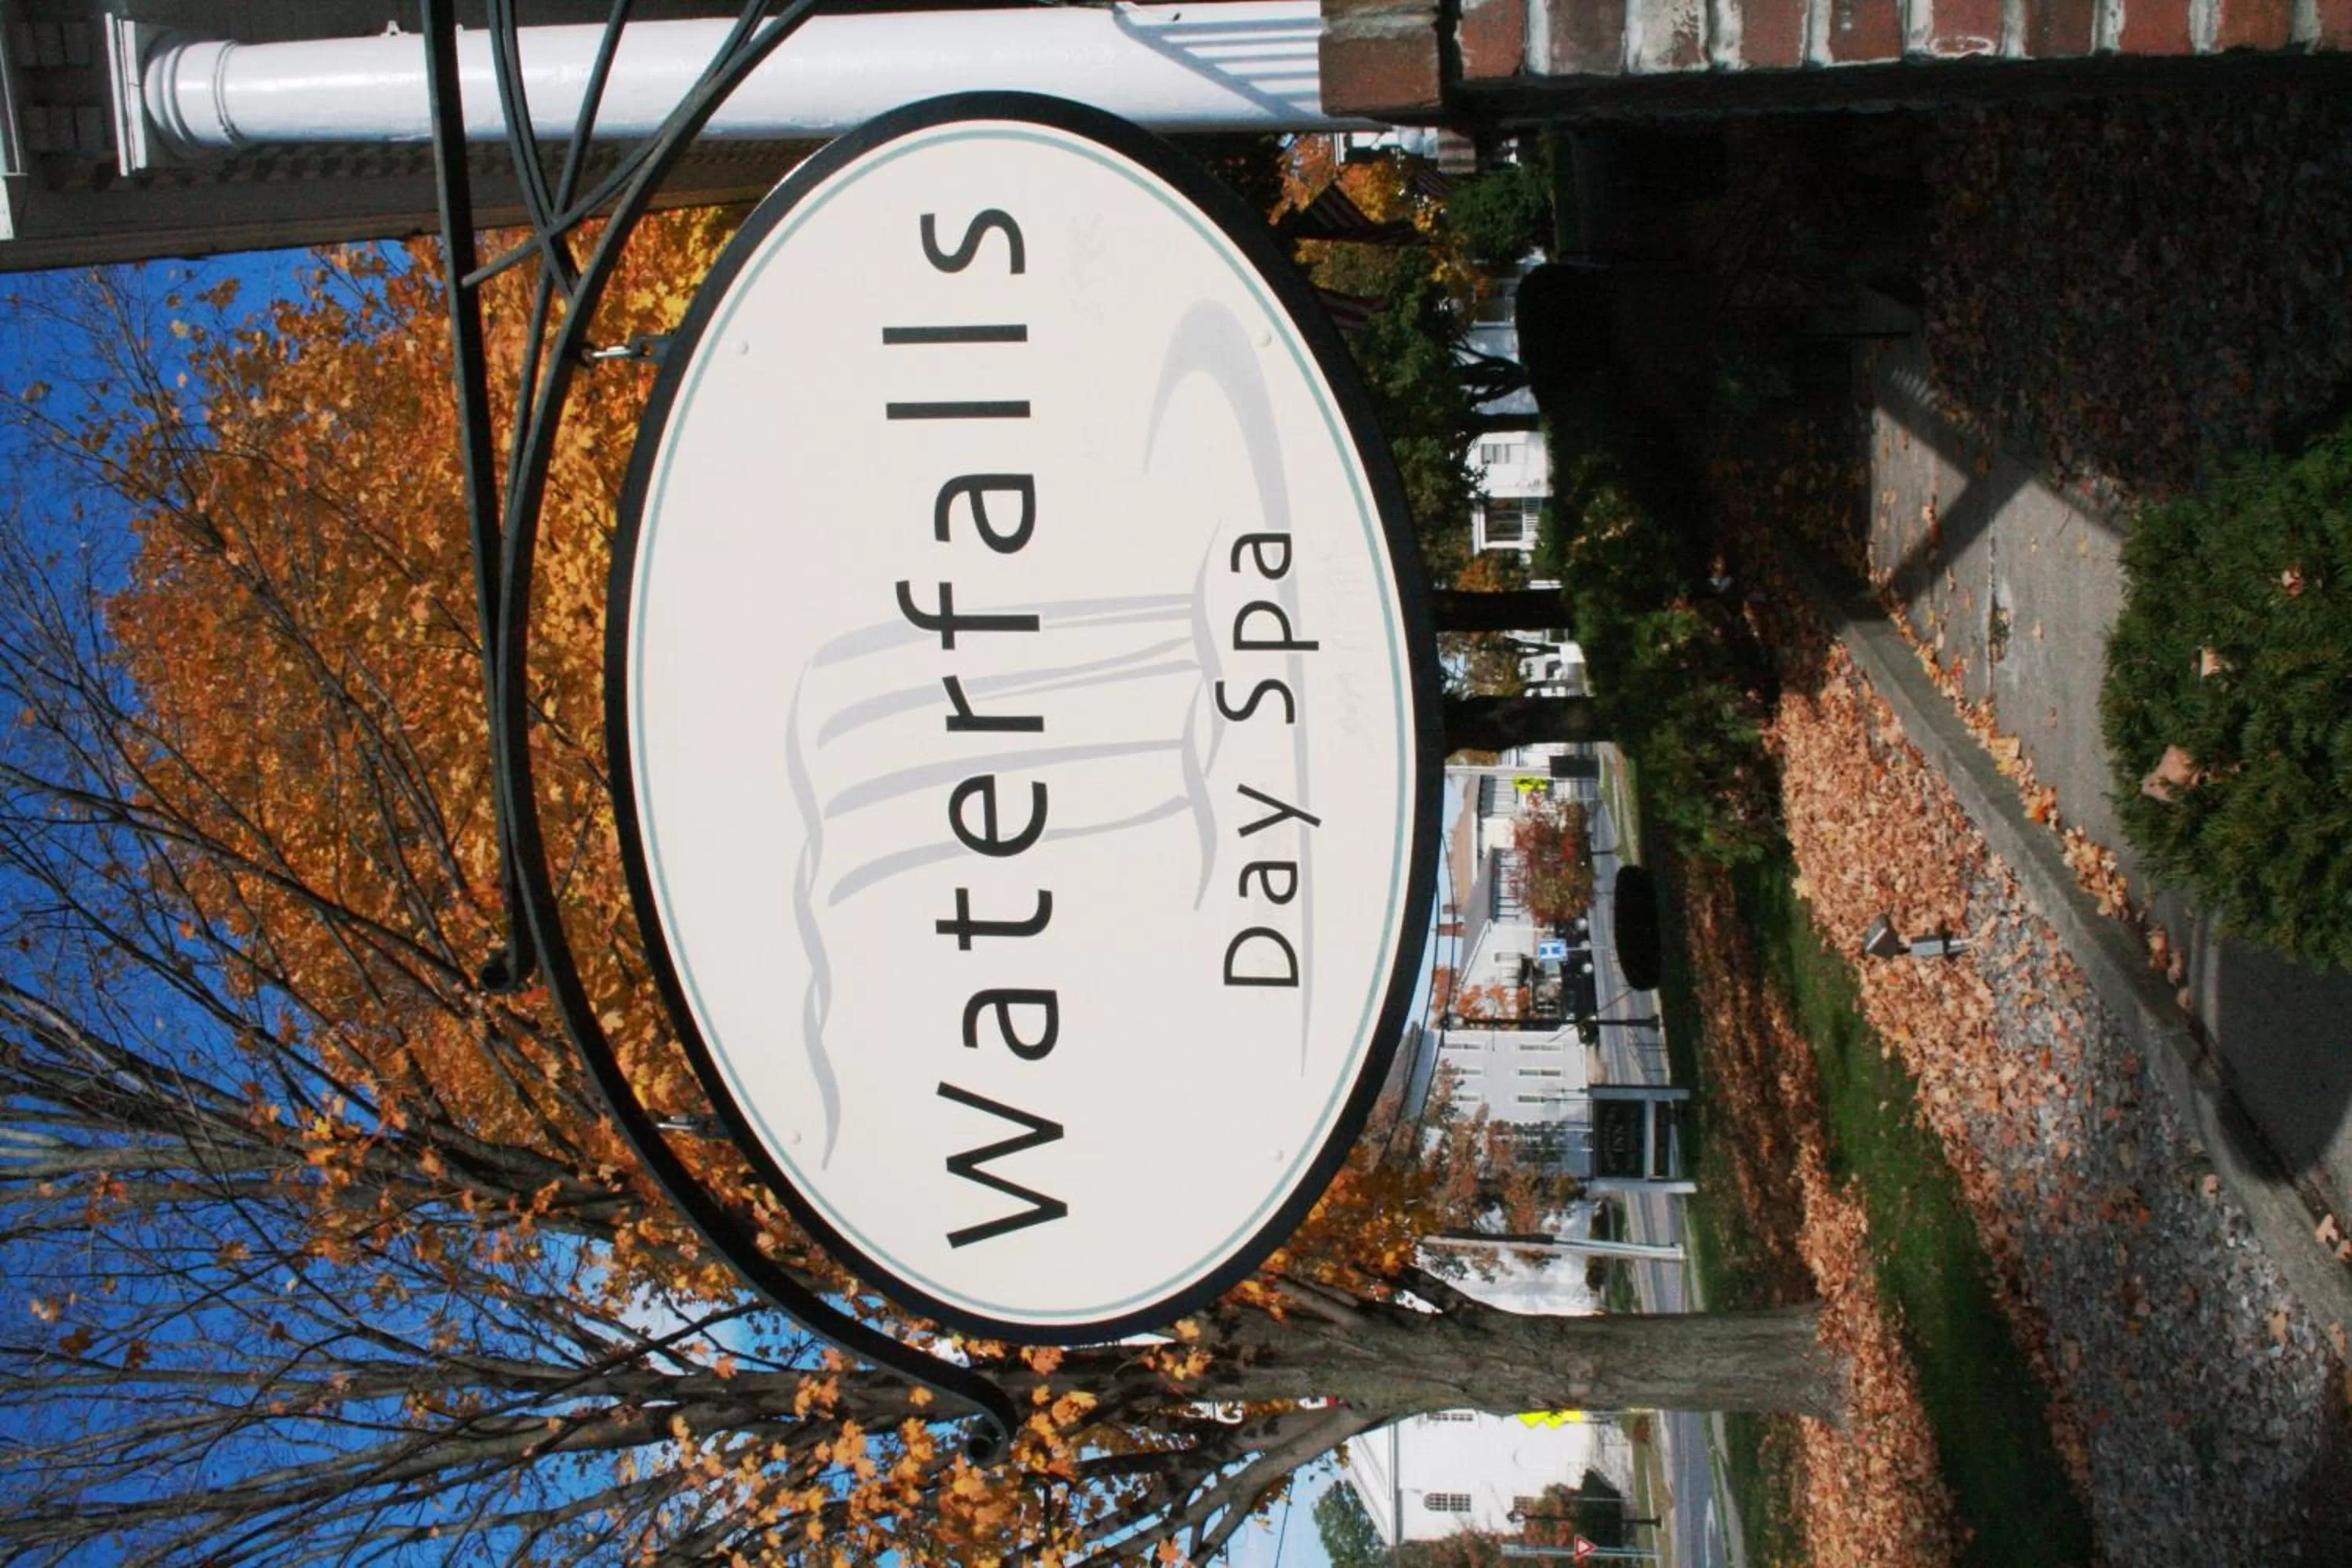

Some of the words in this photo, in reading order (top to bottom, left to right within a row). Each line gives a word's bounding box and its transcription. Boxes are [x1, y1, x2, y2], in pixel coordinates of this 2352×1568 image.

[883, 208, 1068, 1249] Waterfalls
[1215, 532, 1319, 724] Spa
[1224, 783, 1321, 987] Day
